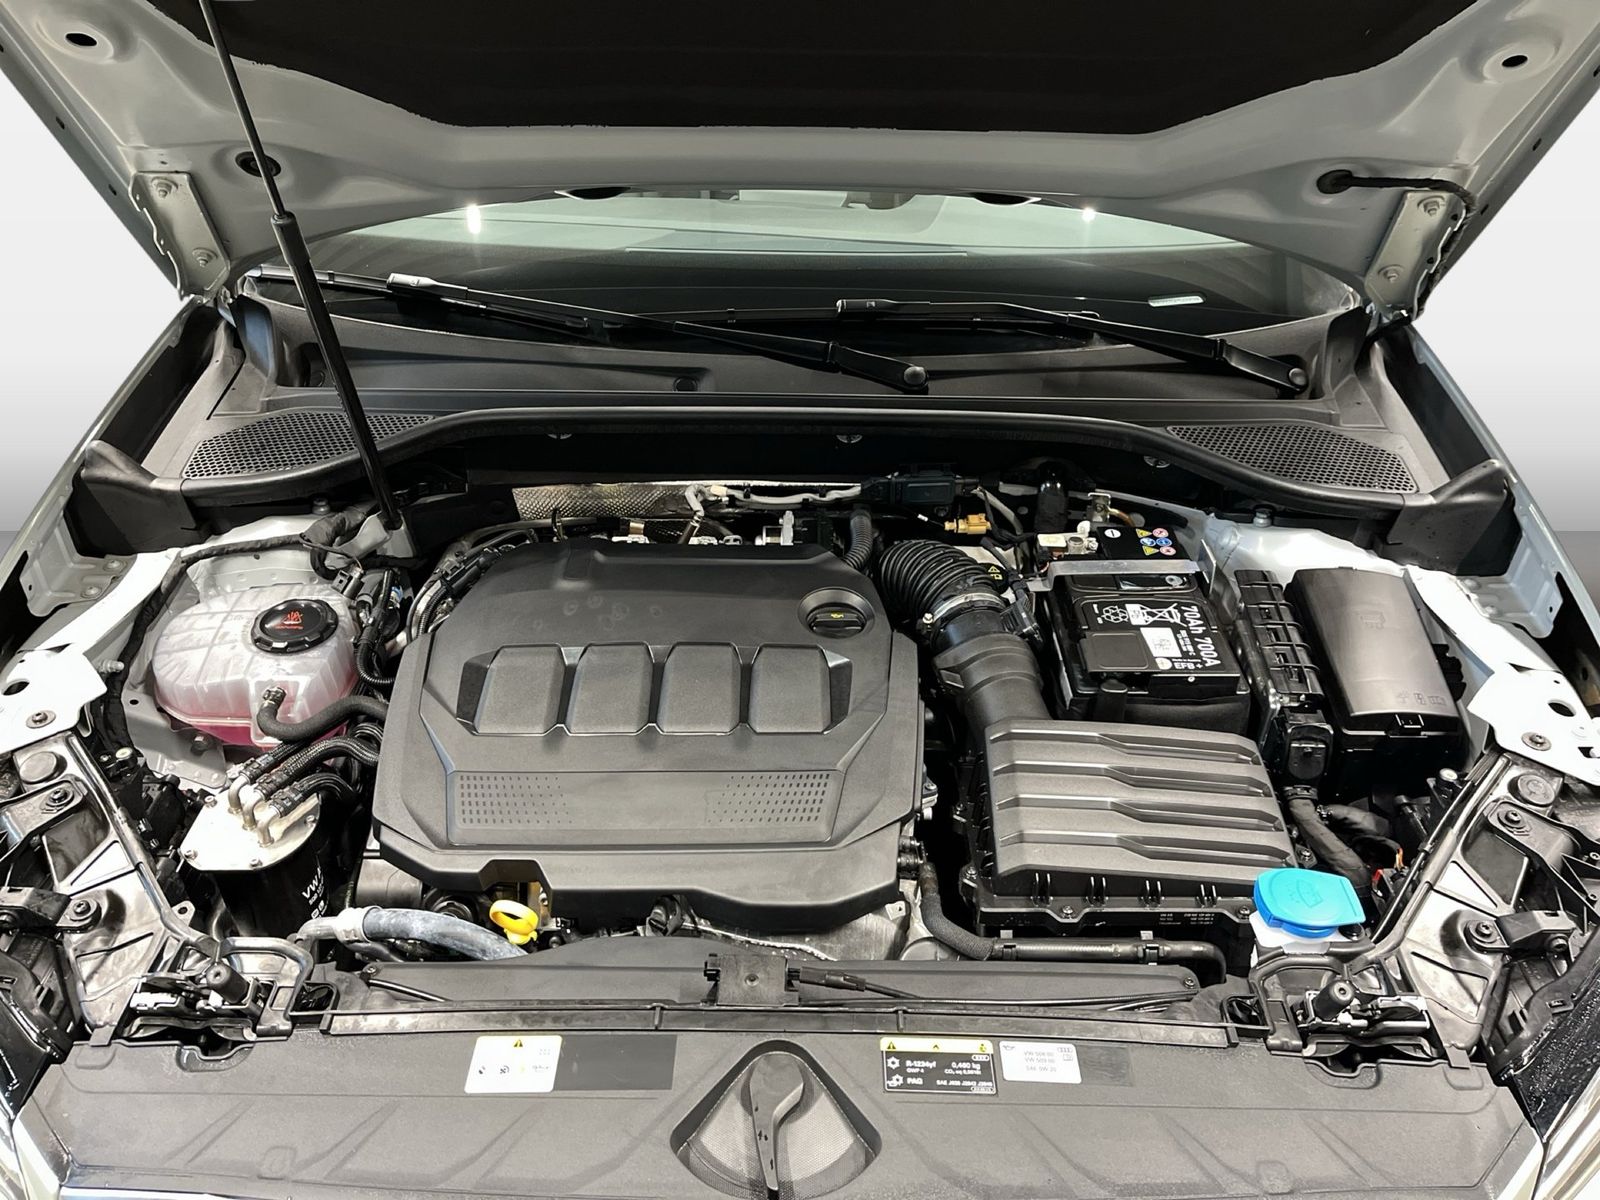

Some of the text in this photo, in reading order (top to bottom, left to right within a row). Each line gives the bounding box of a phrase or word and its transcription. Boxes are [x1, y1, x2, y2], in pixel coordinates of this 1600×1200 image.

[1181, 606, 1206, 634] 70Ah
[1194, 637, 1221, 667] 700A
[906, 1077, 923, 1085] PAG
